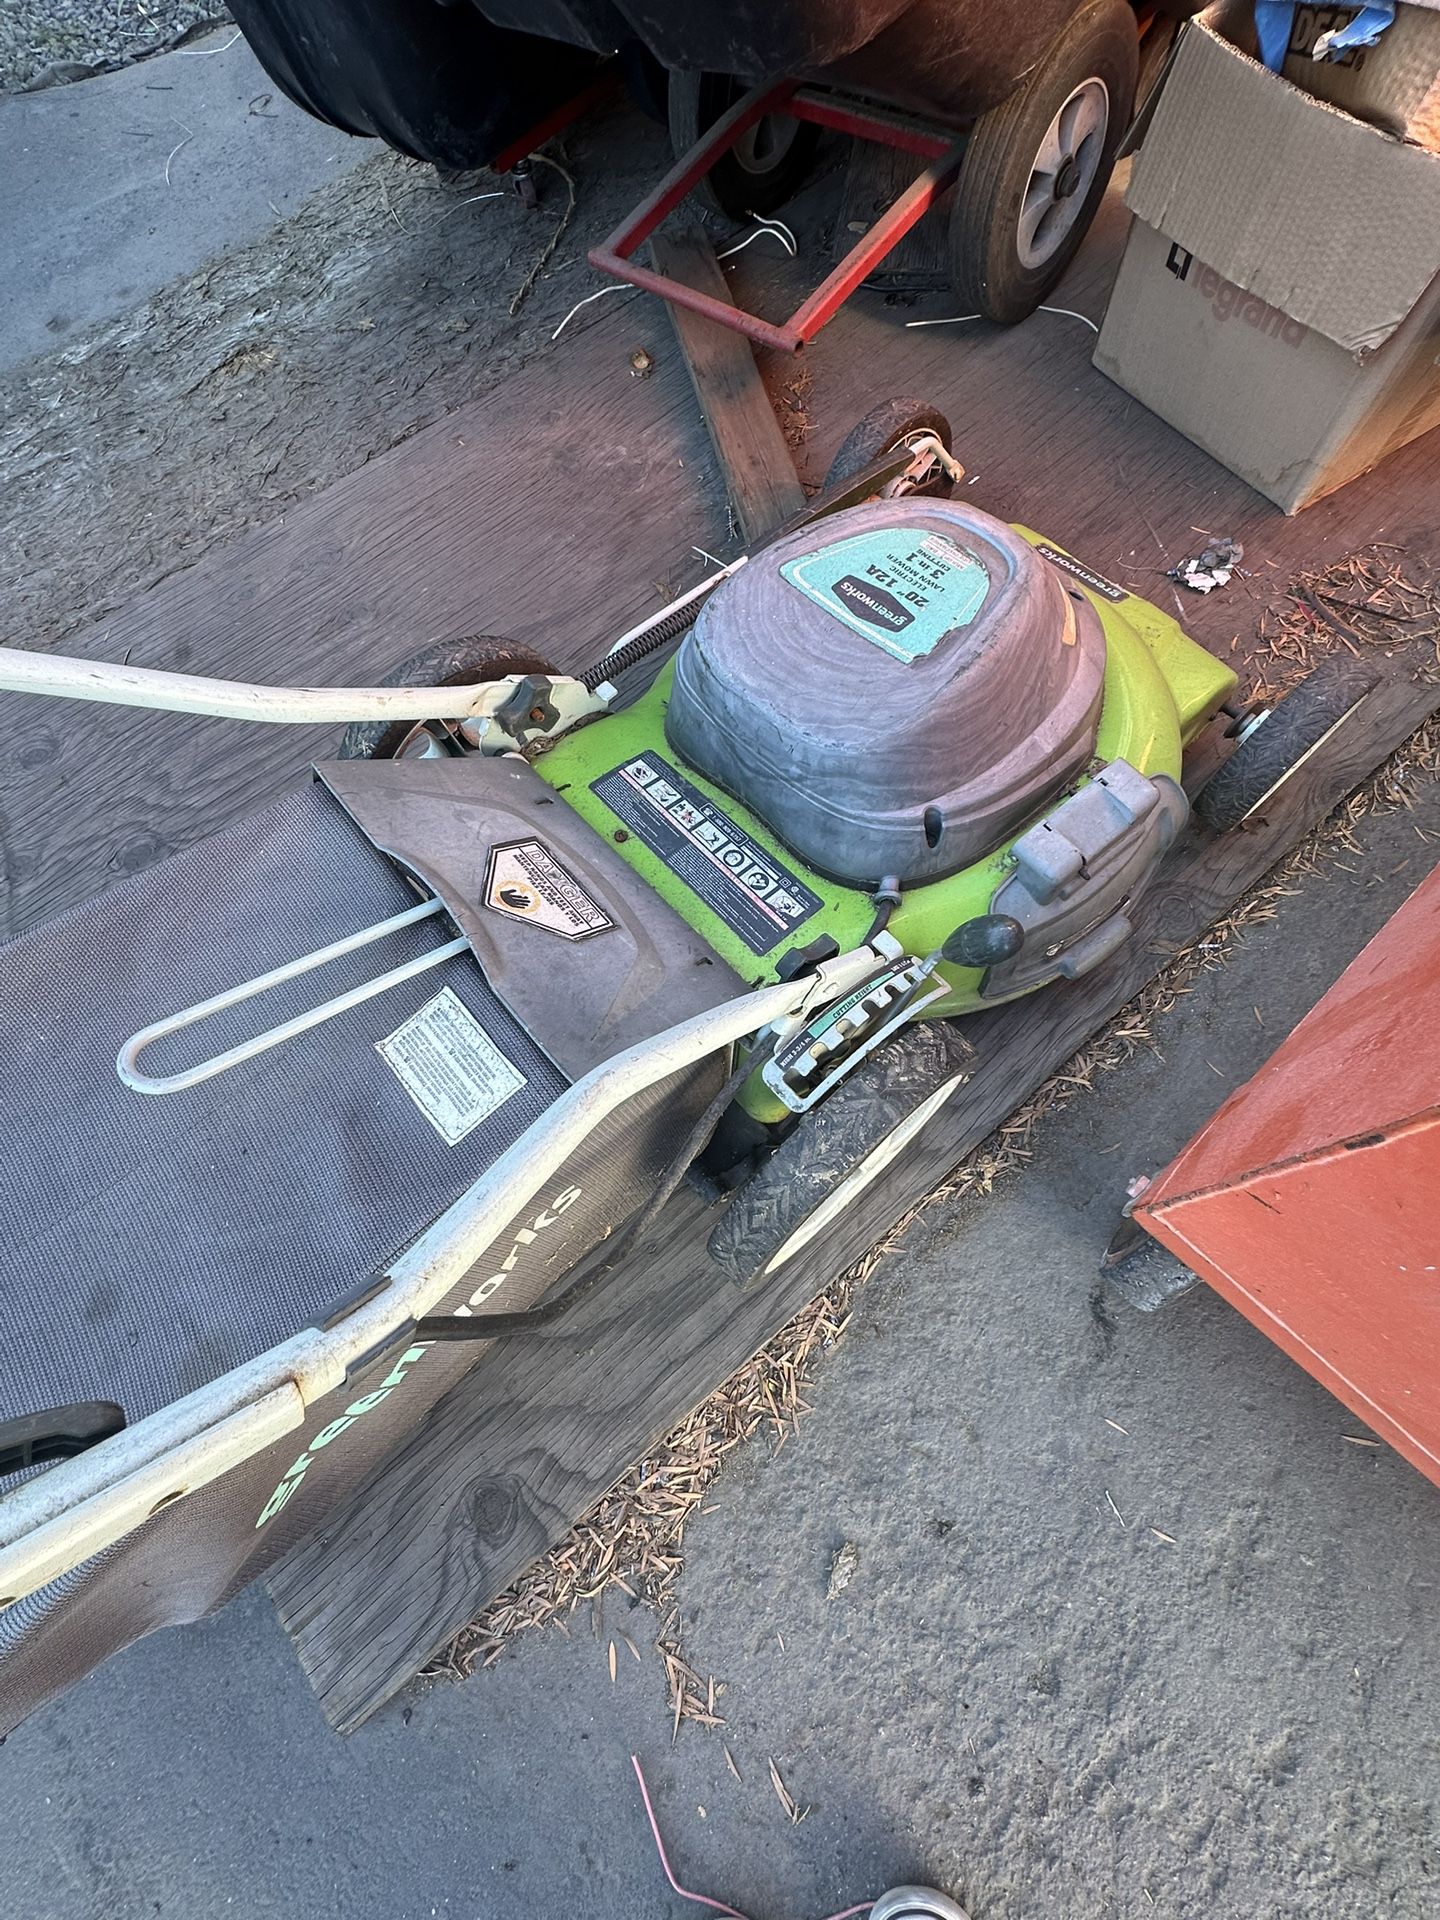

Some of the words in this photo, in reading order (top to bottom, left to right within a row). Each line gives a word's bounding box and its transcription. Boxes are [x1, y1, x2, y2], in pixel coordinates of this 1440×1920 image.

[886, 553, 920, 577] MOWER
[916, 548, 951, 572] CUTTING
[1038, 547, 1122, 598] greenworks
[865, 563, 898, 588] 12A
[889, 565, 927, 592] ELECTRIC
[918, 575, 946, 593] LAWN
[840, 581, 908, 627] greenworks
[896, 590, 930, 608] 20"
[517, 853, 532, 868] KEEP
[530, 866, 547, 885] HANDS
[545, 884, 558, 896] AND
[556, 896, 570, 910] FEET
[569, 908, 585, 925] AWAY
[832, 997, 856, 1019] CUTTING
[854, 984, 873, 1000] HEIGHT
[255, 1184, 583, 1529] greenorks
